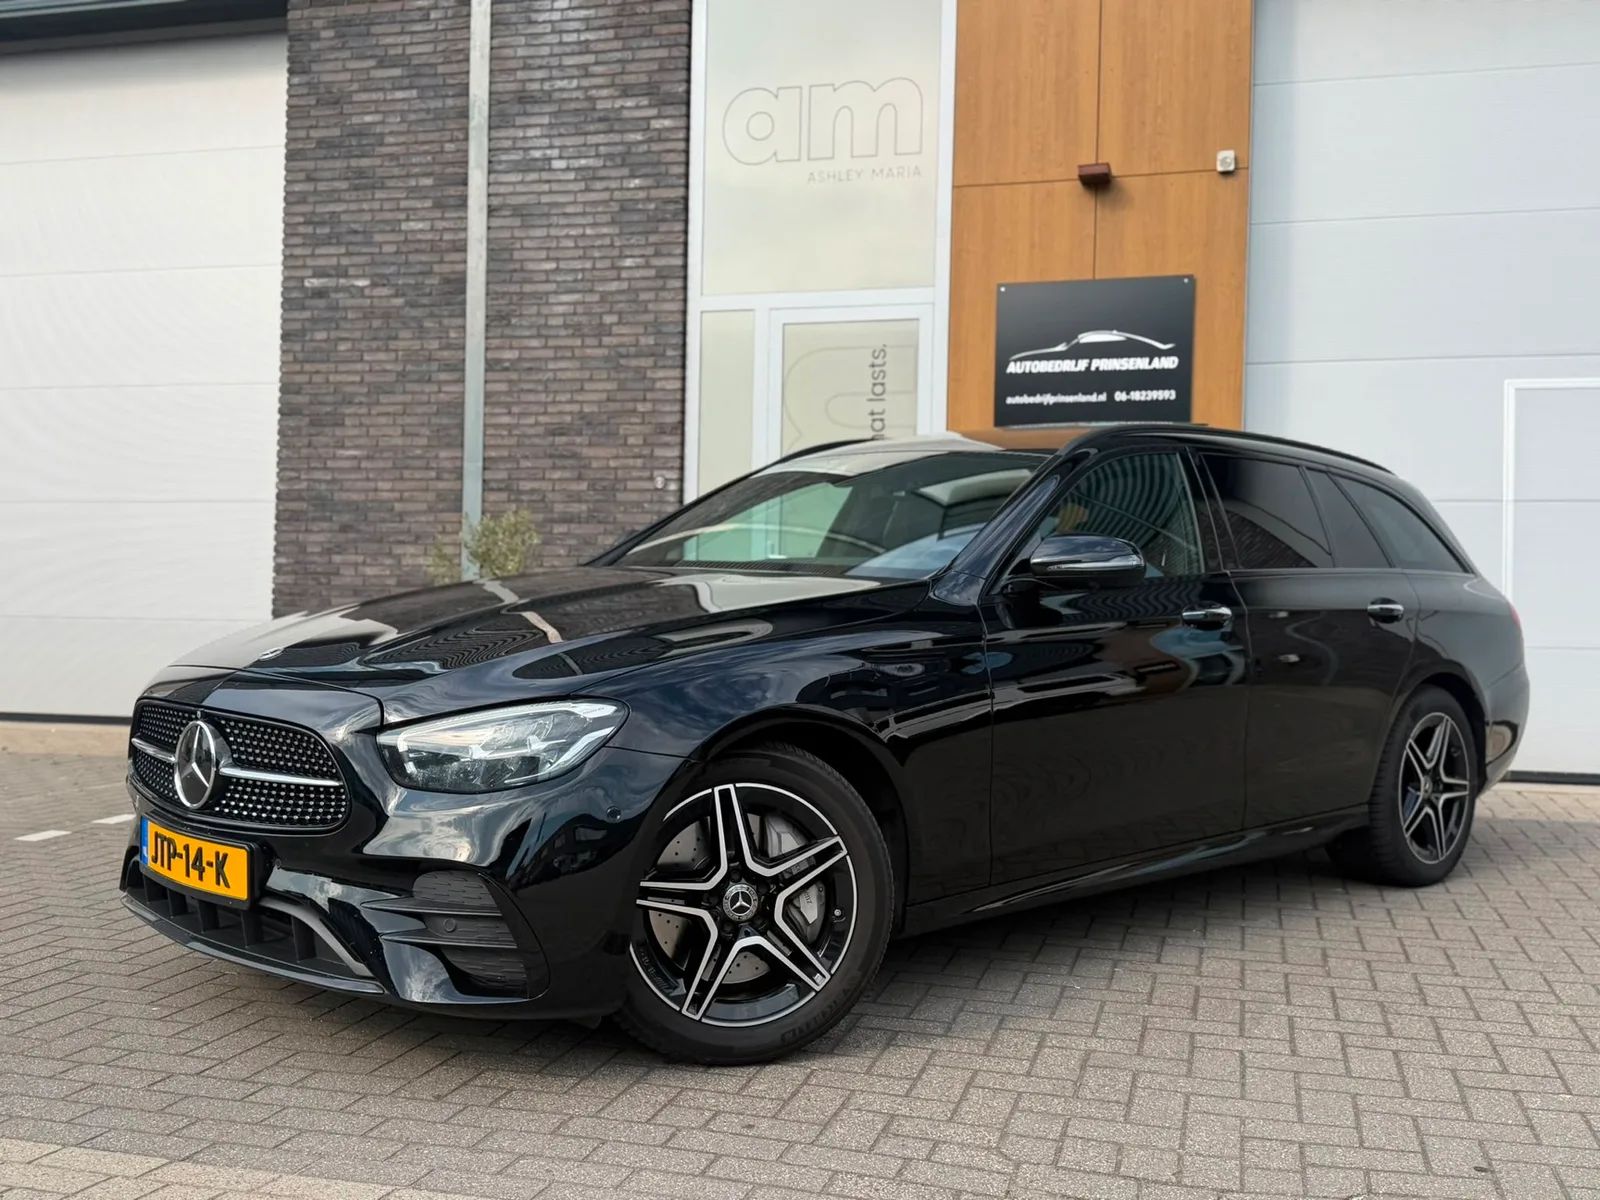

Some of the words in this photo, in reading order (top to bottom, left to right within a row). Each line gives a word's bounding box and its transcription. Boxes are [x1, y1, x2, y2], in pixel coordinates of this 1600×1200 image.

[722, 77, 923, 166] am
[807, 169, 864, 185] ASHLEY
[871, 165, 922, 181] MARIA
[866, 344, 887, 402] lasts.
[1006, 358, 1089, 374] AUTOBEDRIJF
[1090, 356, 1179, 372] PRINSENLAND
[1005, 391, 1107, 406] autobedrijfprinsenland.nl
[151, 831, 231, 889] JTP-14-K
